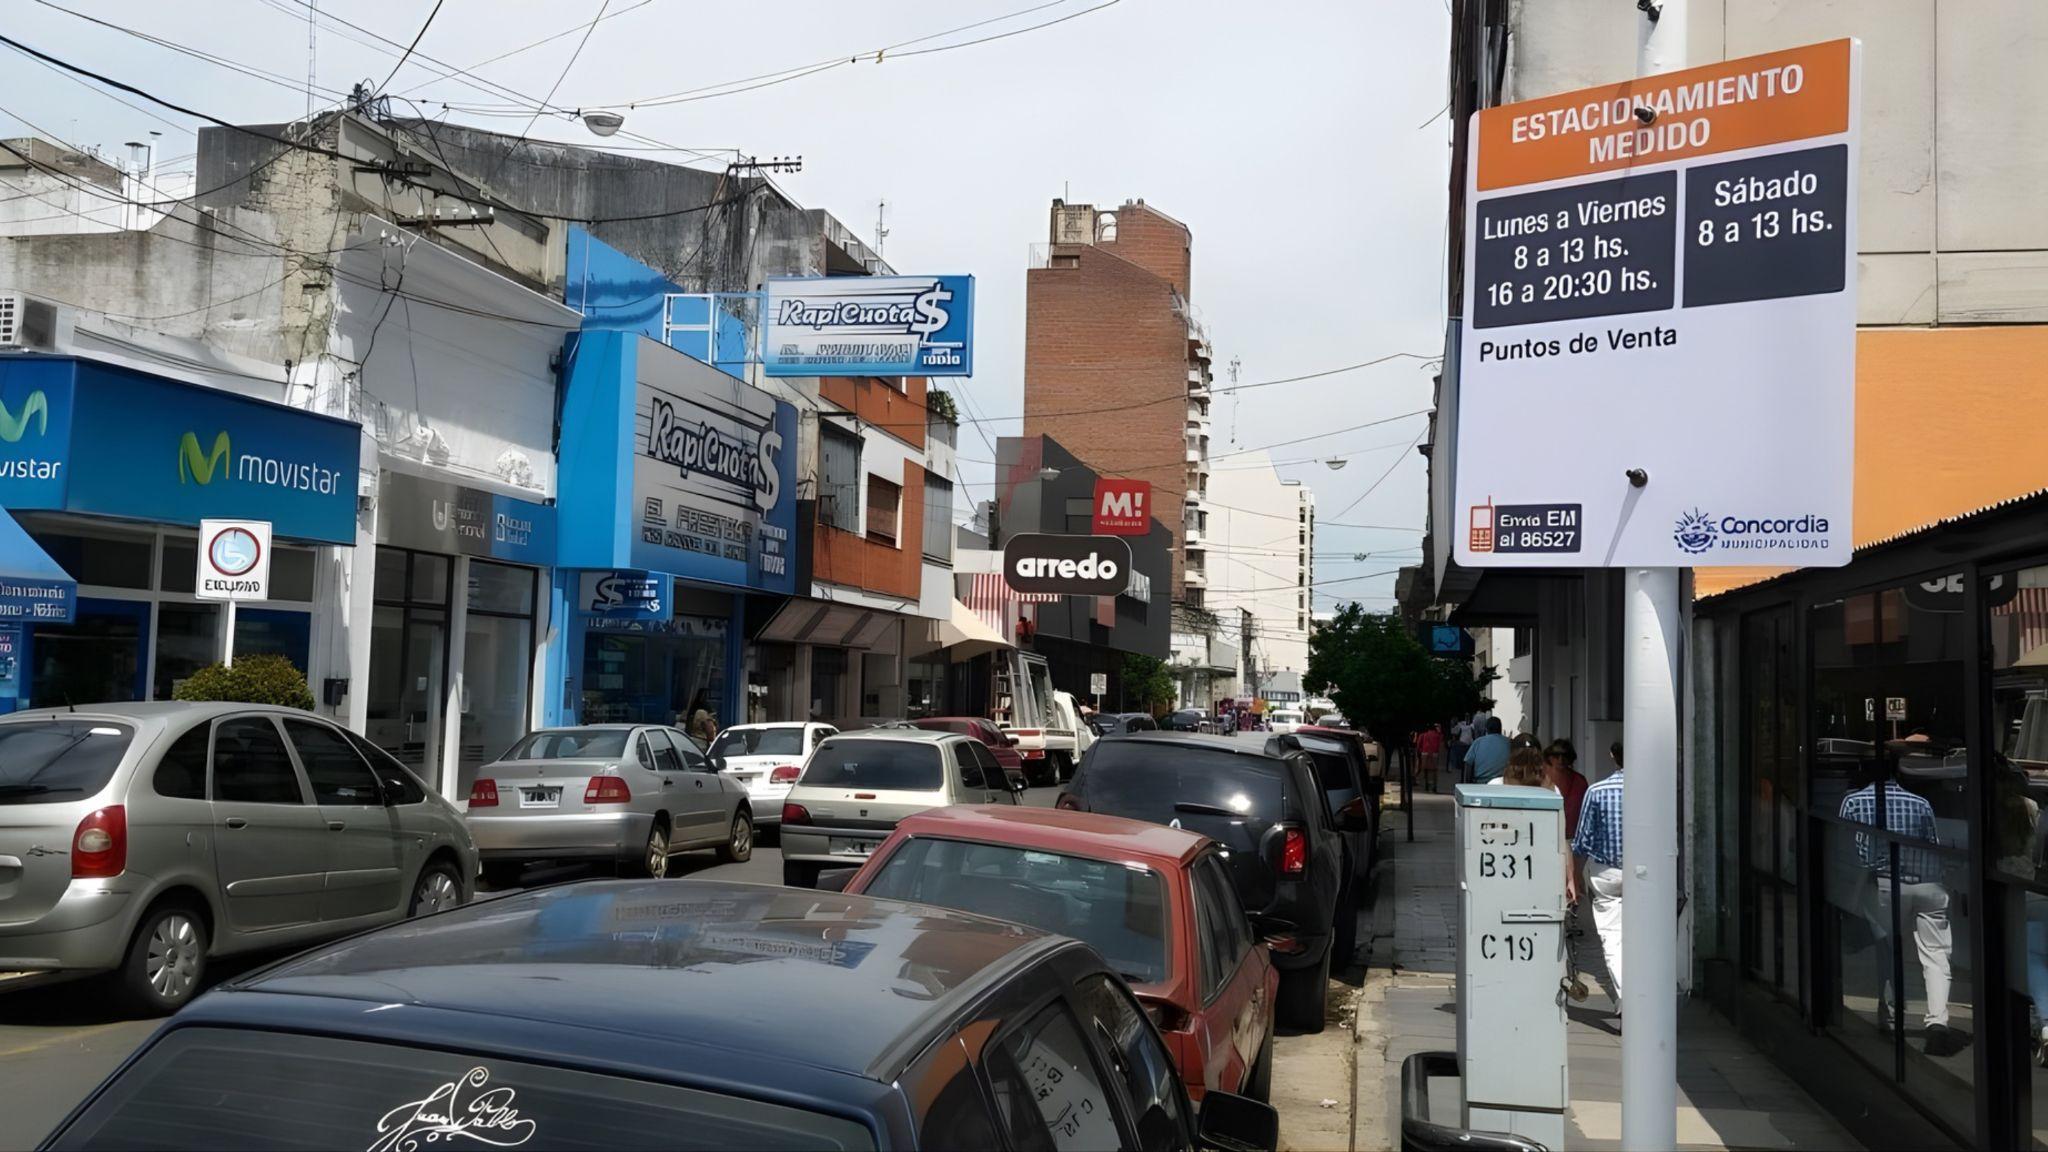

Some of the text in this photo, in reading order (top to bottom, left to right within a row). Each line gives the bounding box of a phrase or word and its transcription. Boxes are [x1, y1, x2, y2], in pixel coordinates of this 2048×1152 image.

[1512, 63, 1804, 143] ESTACIONAMIENTO
[1589, 117, 1710, 164] MEDIDO
[1714, 170, 1817, 207] Sábado
[1484, 196, 1666, 240] Lunes a Viernes
[1698, 208, 1832, 246] 8 a 13 hs.
[1514, 235, 1629, 270] 8 a 13 hs.
[1488, 267, 1657, 307] 16 a 20:30 hs.
[1480, 326, 1677, 362] Puntos de Venta
[239, 454, 341, 495] movistar
[1500, 531, 1575, 547] al 86527
[1721, 514, 1829, 534] Concordia
[1016, 552, 1118, 580] arredo
[1480, 852, 1532, 879] B31
[1482, 934, 1534, 960] C19
